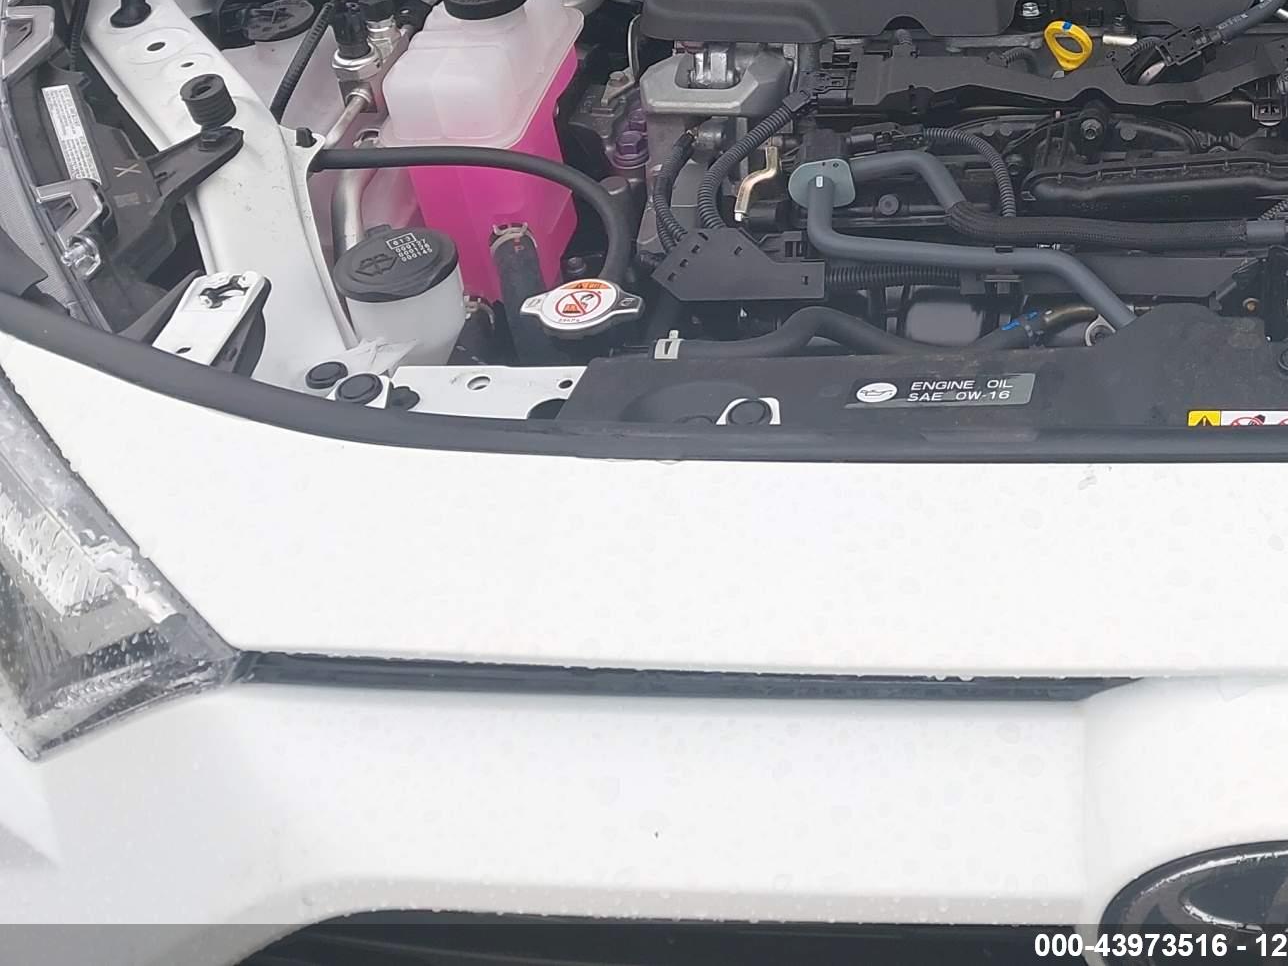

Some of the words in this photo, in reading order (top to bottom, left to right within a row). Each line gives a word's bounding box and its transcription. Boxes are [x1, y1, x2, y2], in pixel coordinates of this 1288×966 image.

[910, 380, 976, 391] ENGINE
[986, 379, 1014, 389] OIL
[907, 393, 944, 402] SAE
